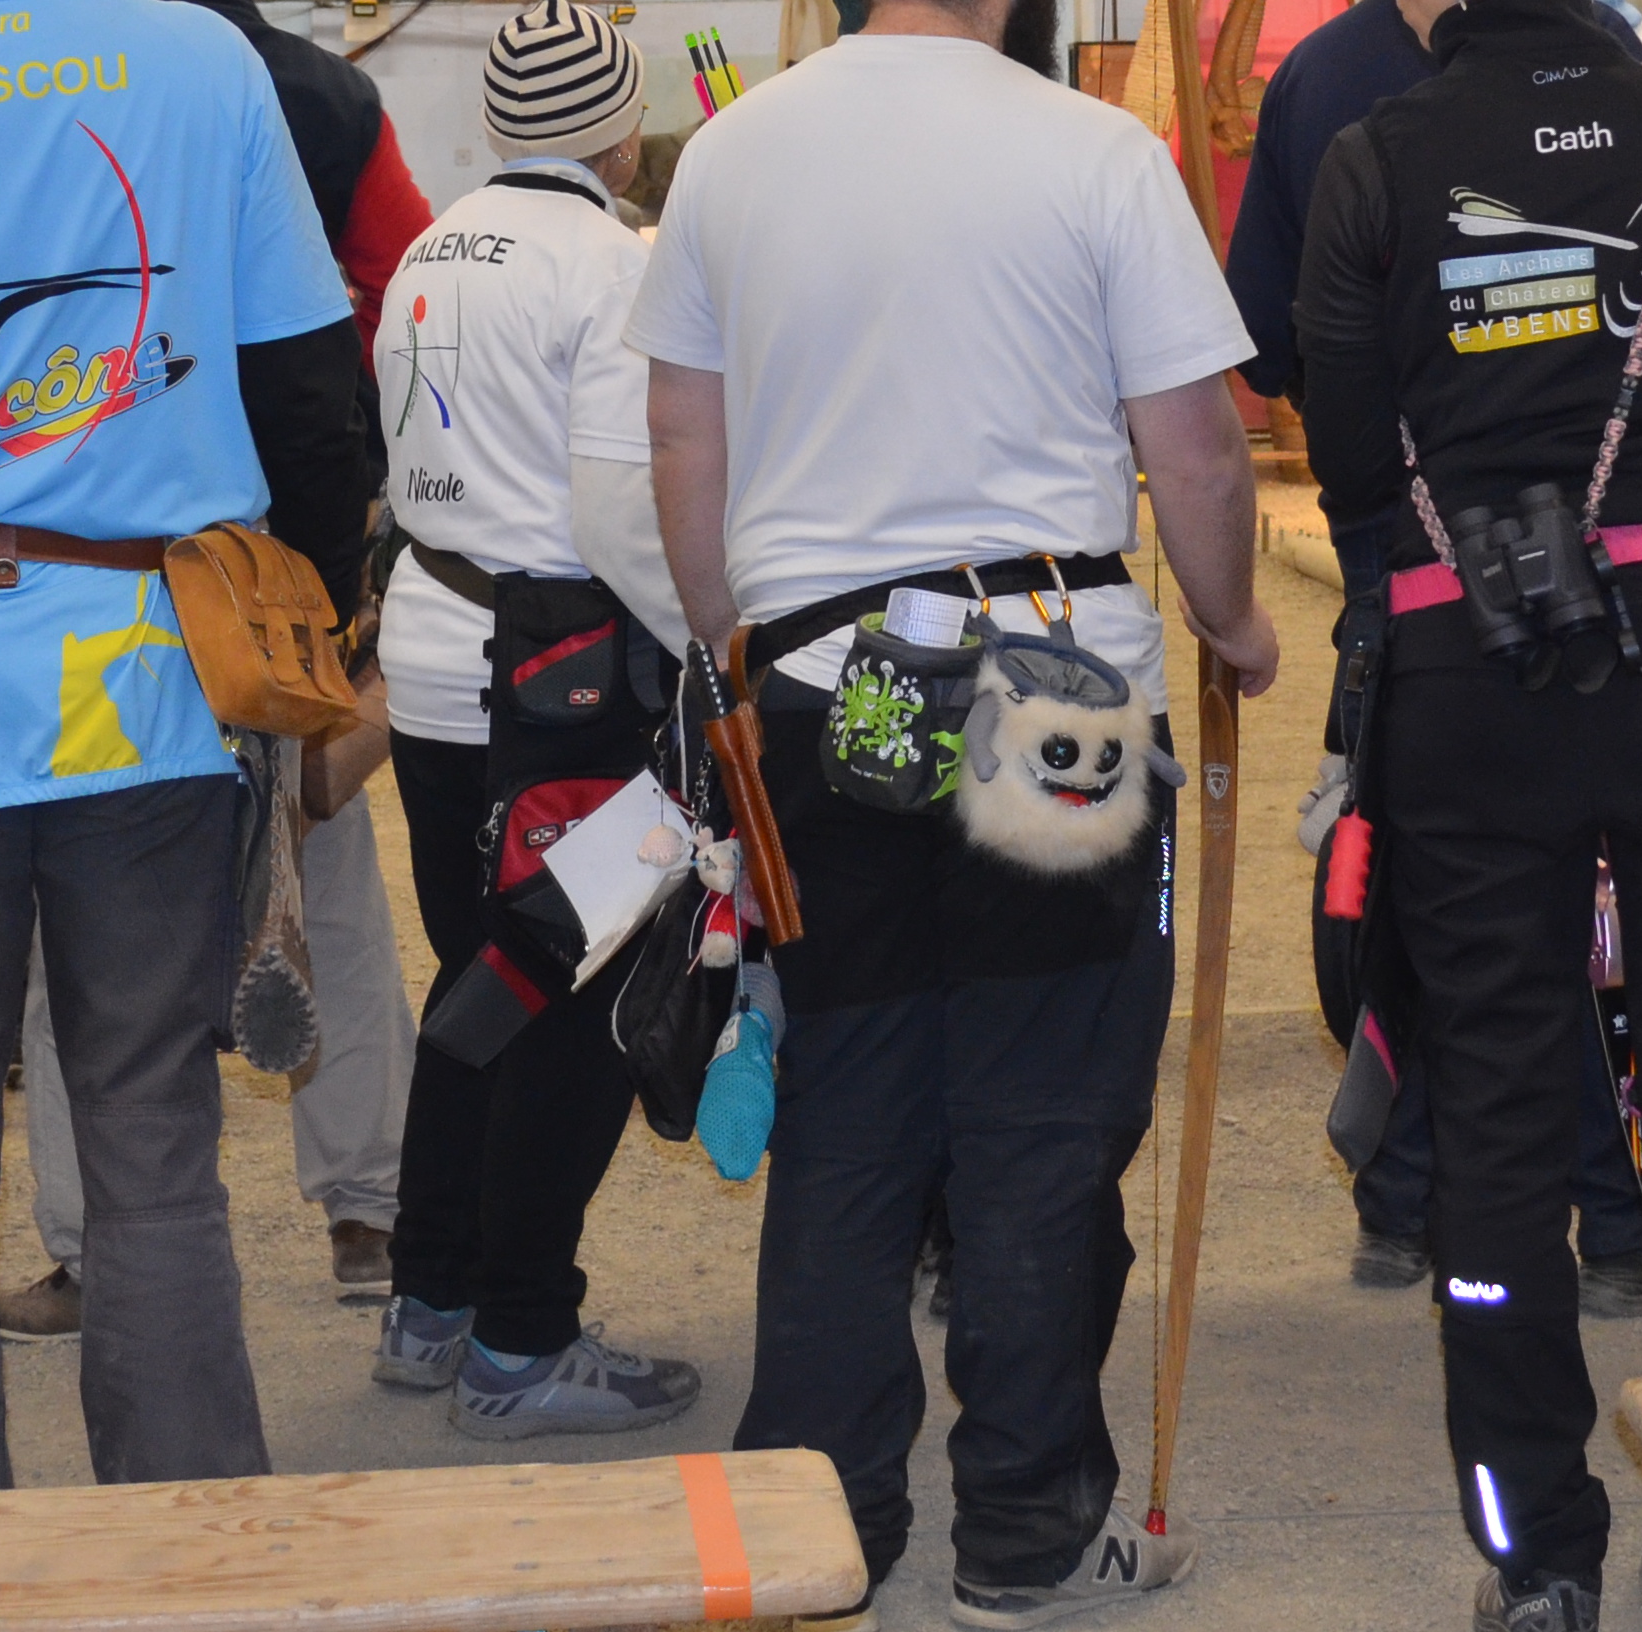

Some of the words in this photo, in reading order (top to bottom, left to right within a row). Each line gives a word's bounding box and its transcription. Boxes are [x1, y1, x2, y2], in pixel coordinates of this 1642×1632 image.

[1534, 120, 1614, 154] Cath
[1444, 266, 1484, 283] Les
[1498, 251, 1590, 277] Archers
[1449, 294, 1476, 312] du
[1452, 306, 1594, 344] EYBENS
[407, 466, 466, 504] Nicole
[1094, 1534, 1140, 1584] N
